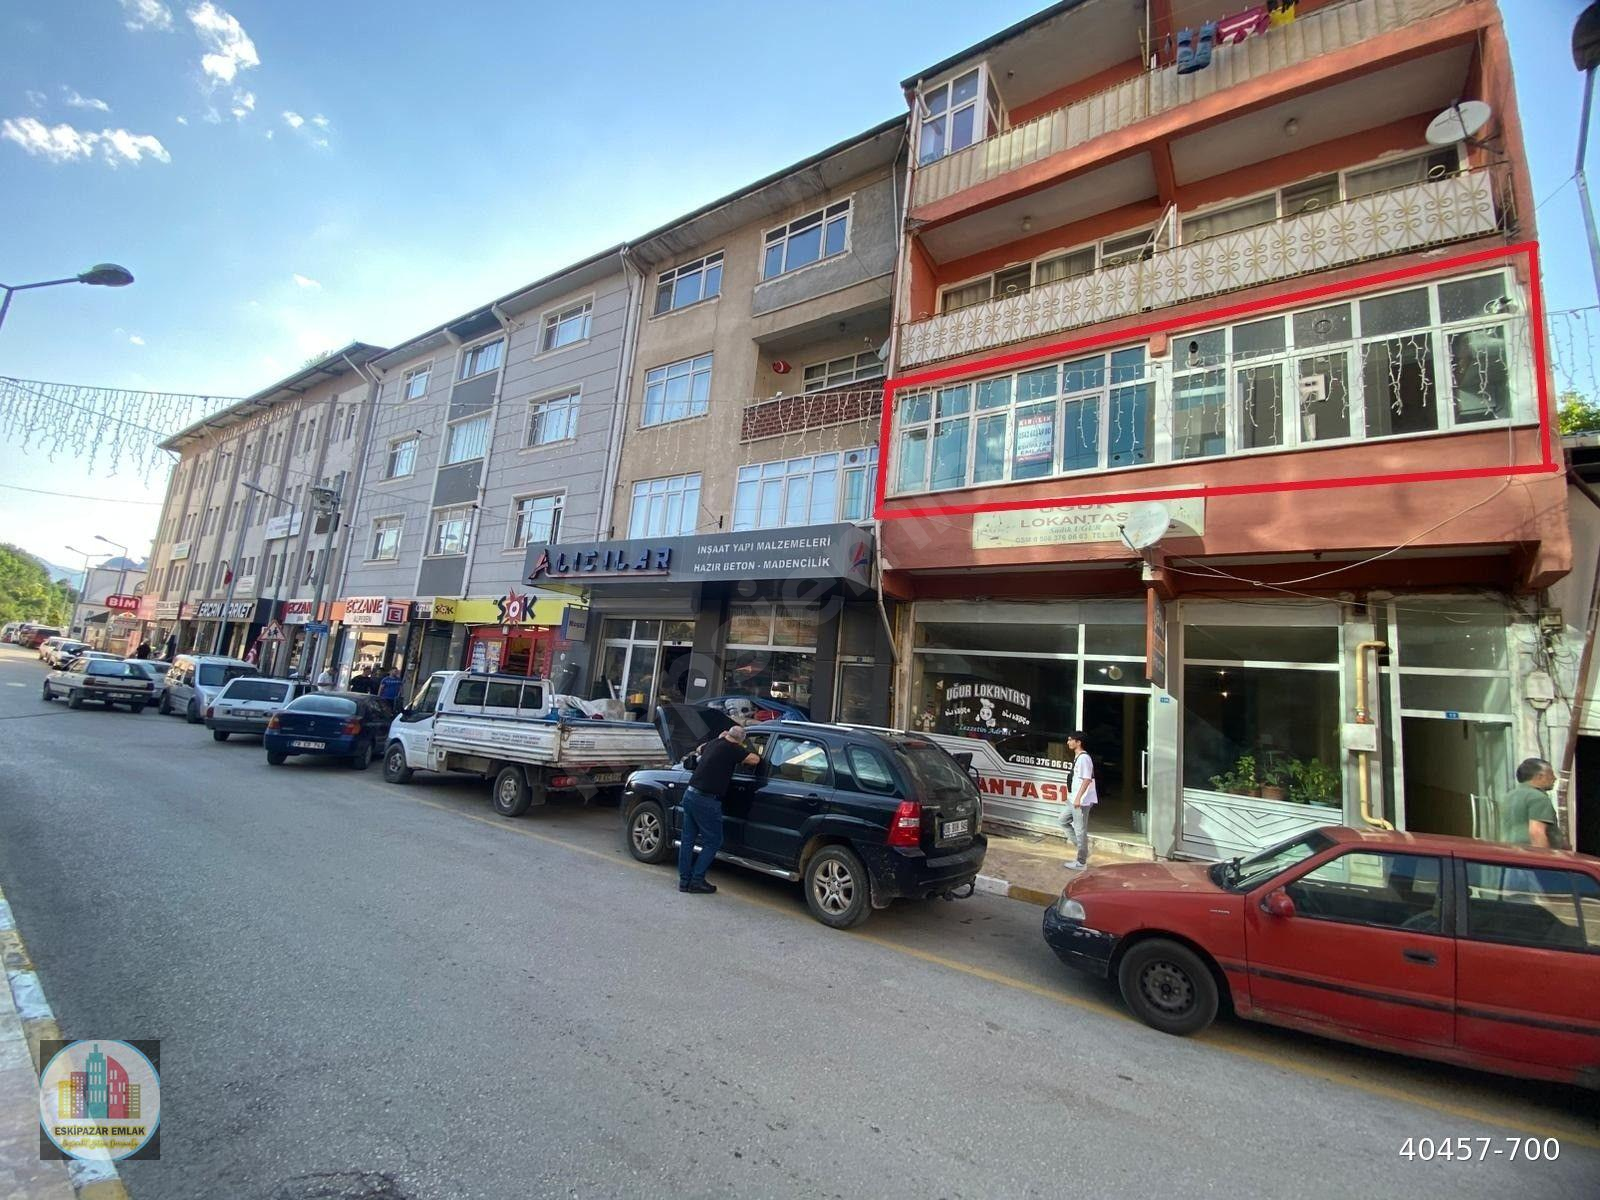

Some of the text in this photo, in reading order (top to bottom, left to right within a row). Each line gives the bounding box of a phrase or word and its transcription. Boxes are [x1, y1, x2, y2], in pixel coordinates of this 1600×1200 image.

[697, 535, 831, 555] İNŞAAT YAPI MALZEMELERİ
[693, 562, 721, 573] HAZIR
[723, 560, 755, 571] BETON
[763, 557, 831, 570] MADENCİLİK
[288, 602, 312, 614] ECZAN
[346, 599, 384, 613] ECZANE
[946, 682, 972, 701] UĞUR
[1016, 755, 1073, 770] 0506 376 06 63
